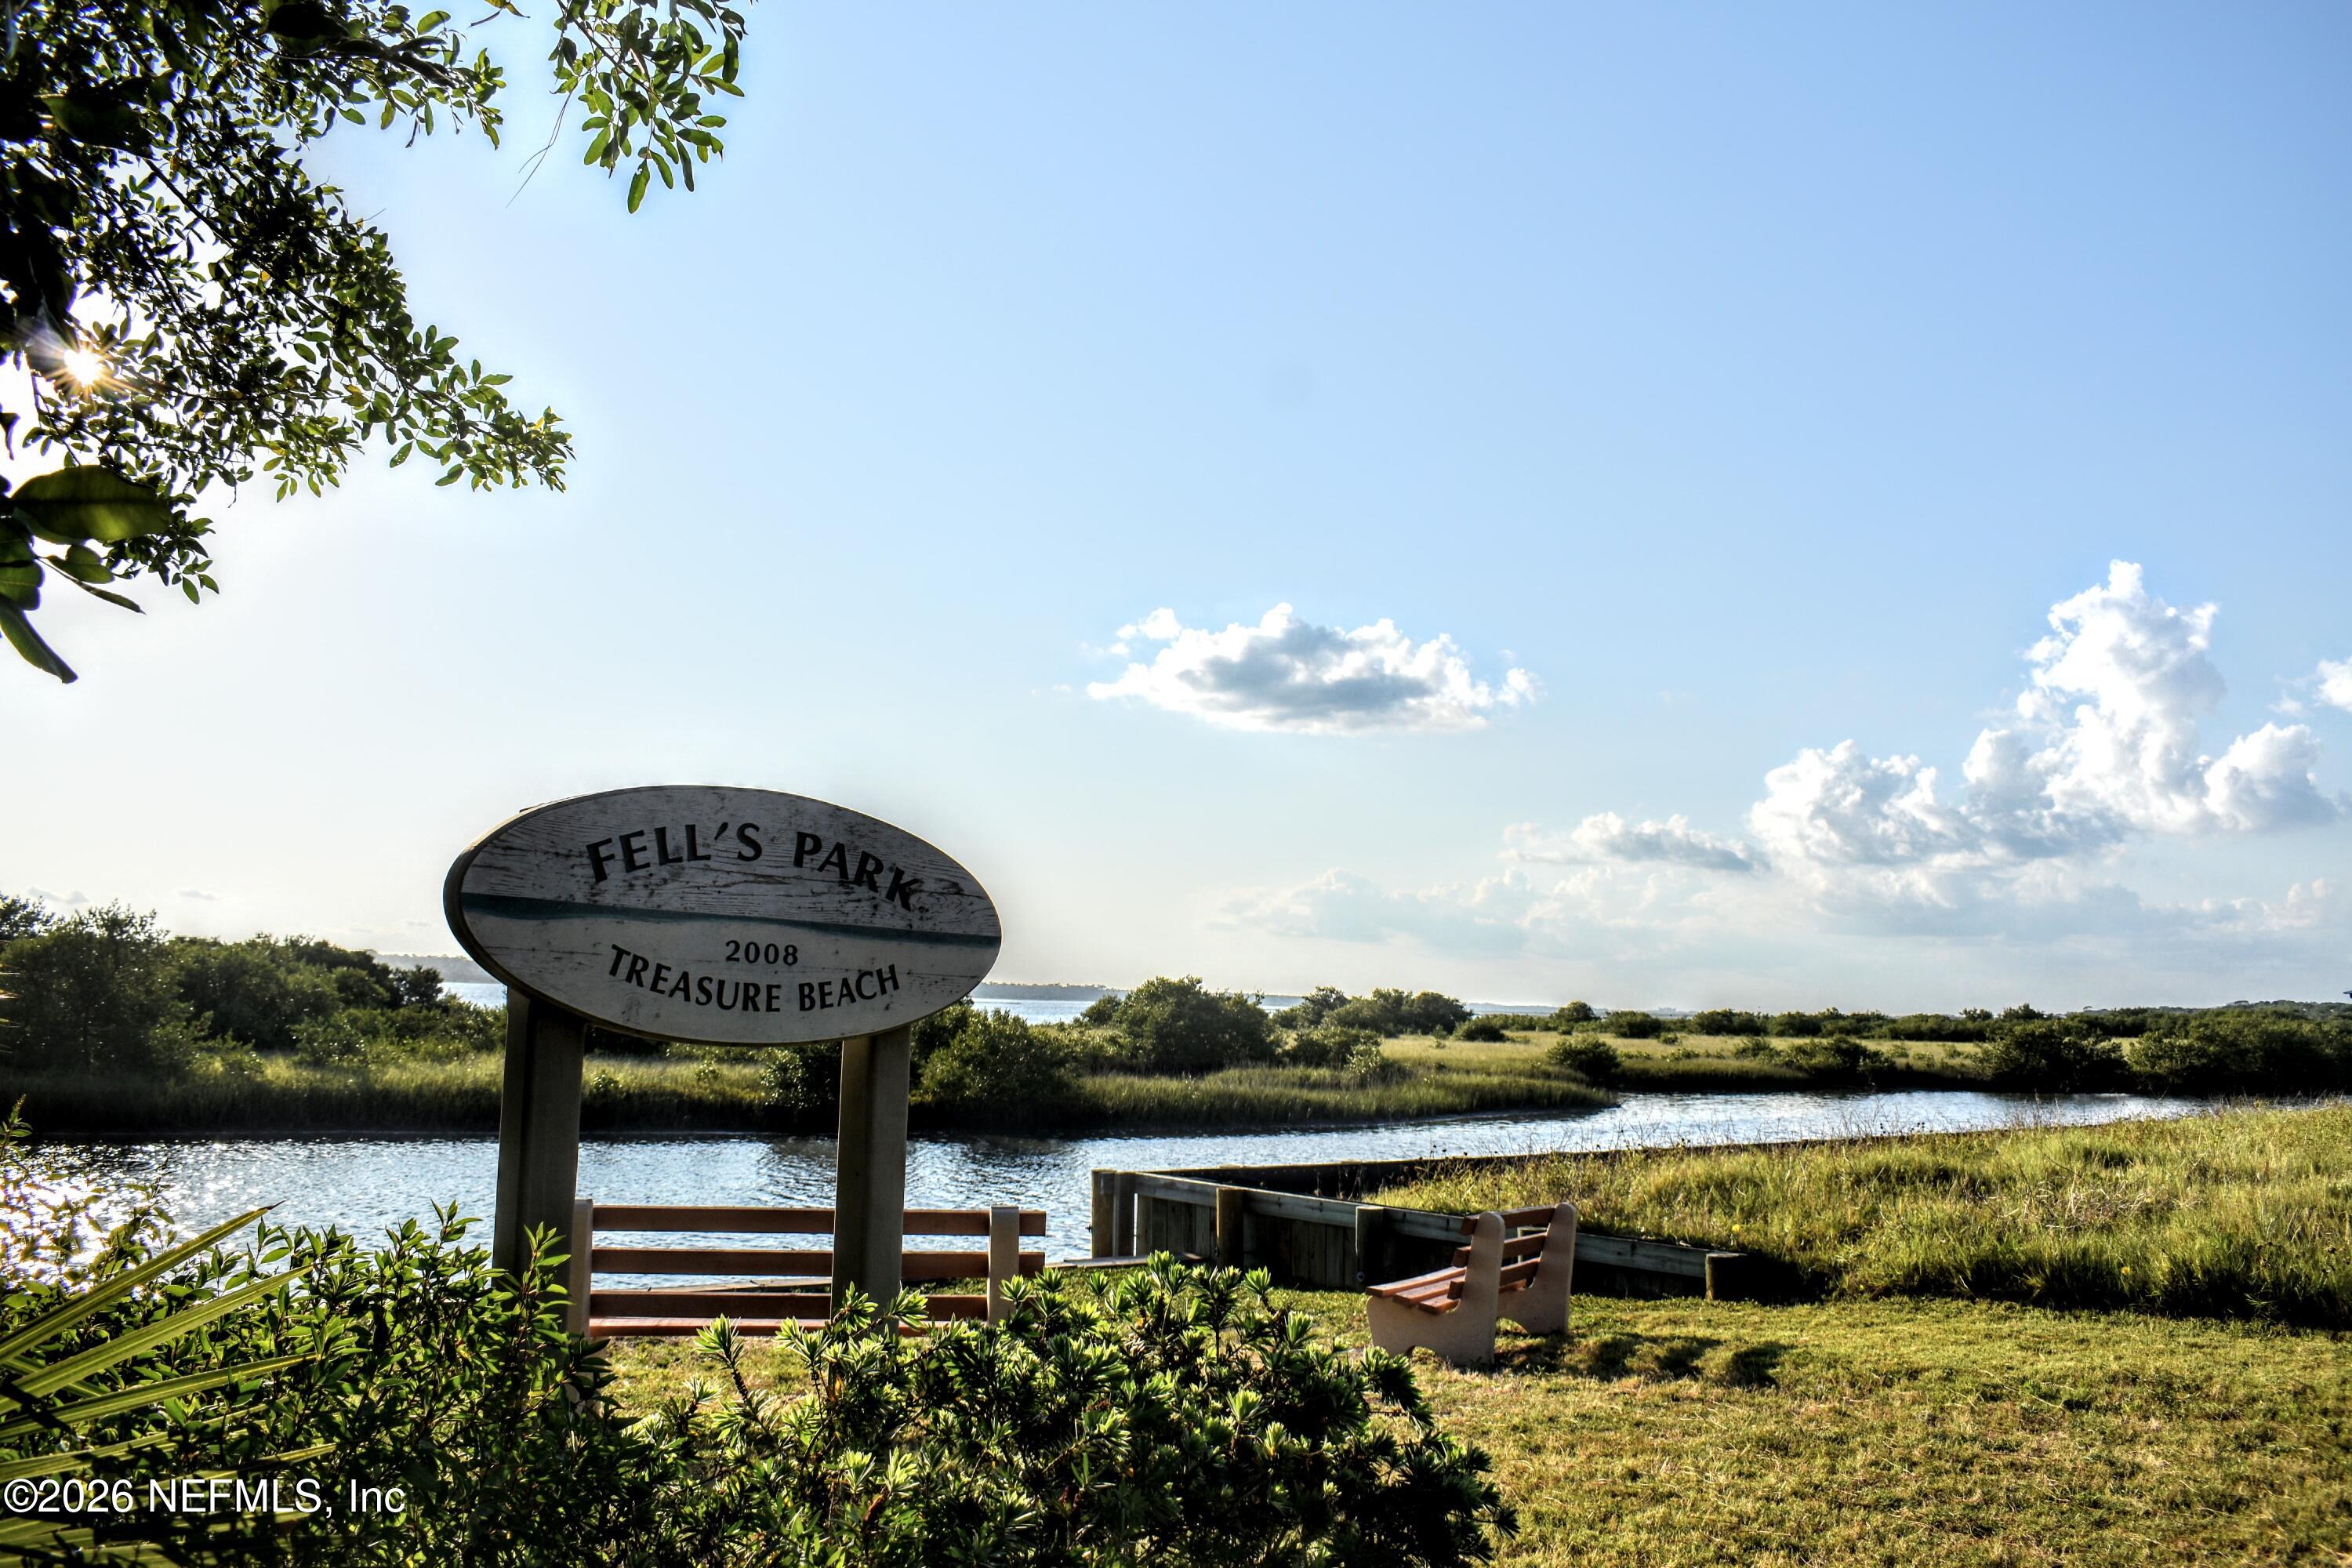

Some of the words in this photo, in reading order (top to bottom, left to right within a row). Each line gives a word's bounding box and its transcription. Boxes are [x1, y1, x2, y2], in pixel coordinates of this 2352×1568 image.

[585, 821, 764, 883] FELL'S
[792, 830, 923, 910] PARK
[608, 943, 782, 1012] TREASURE
[798, 963, 900, 1012] BEACH
[724, 939, 800, 966] 2008
